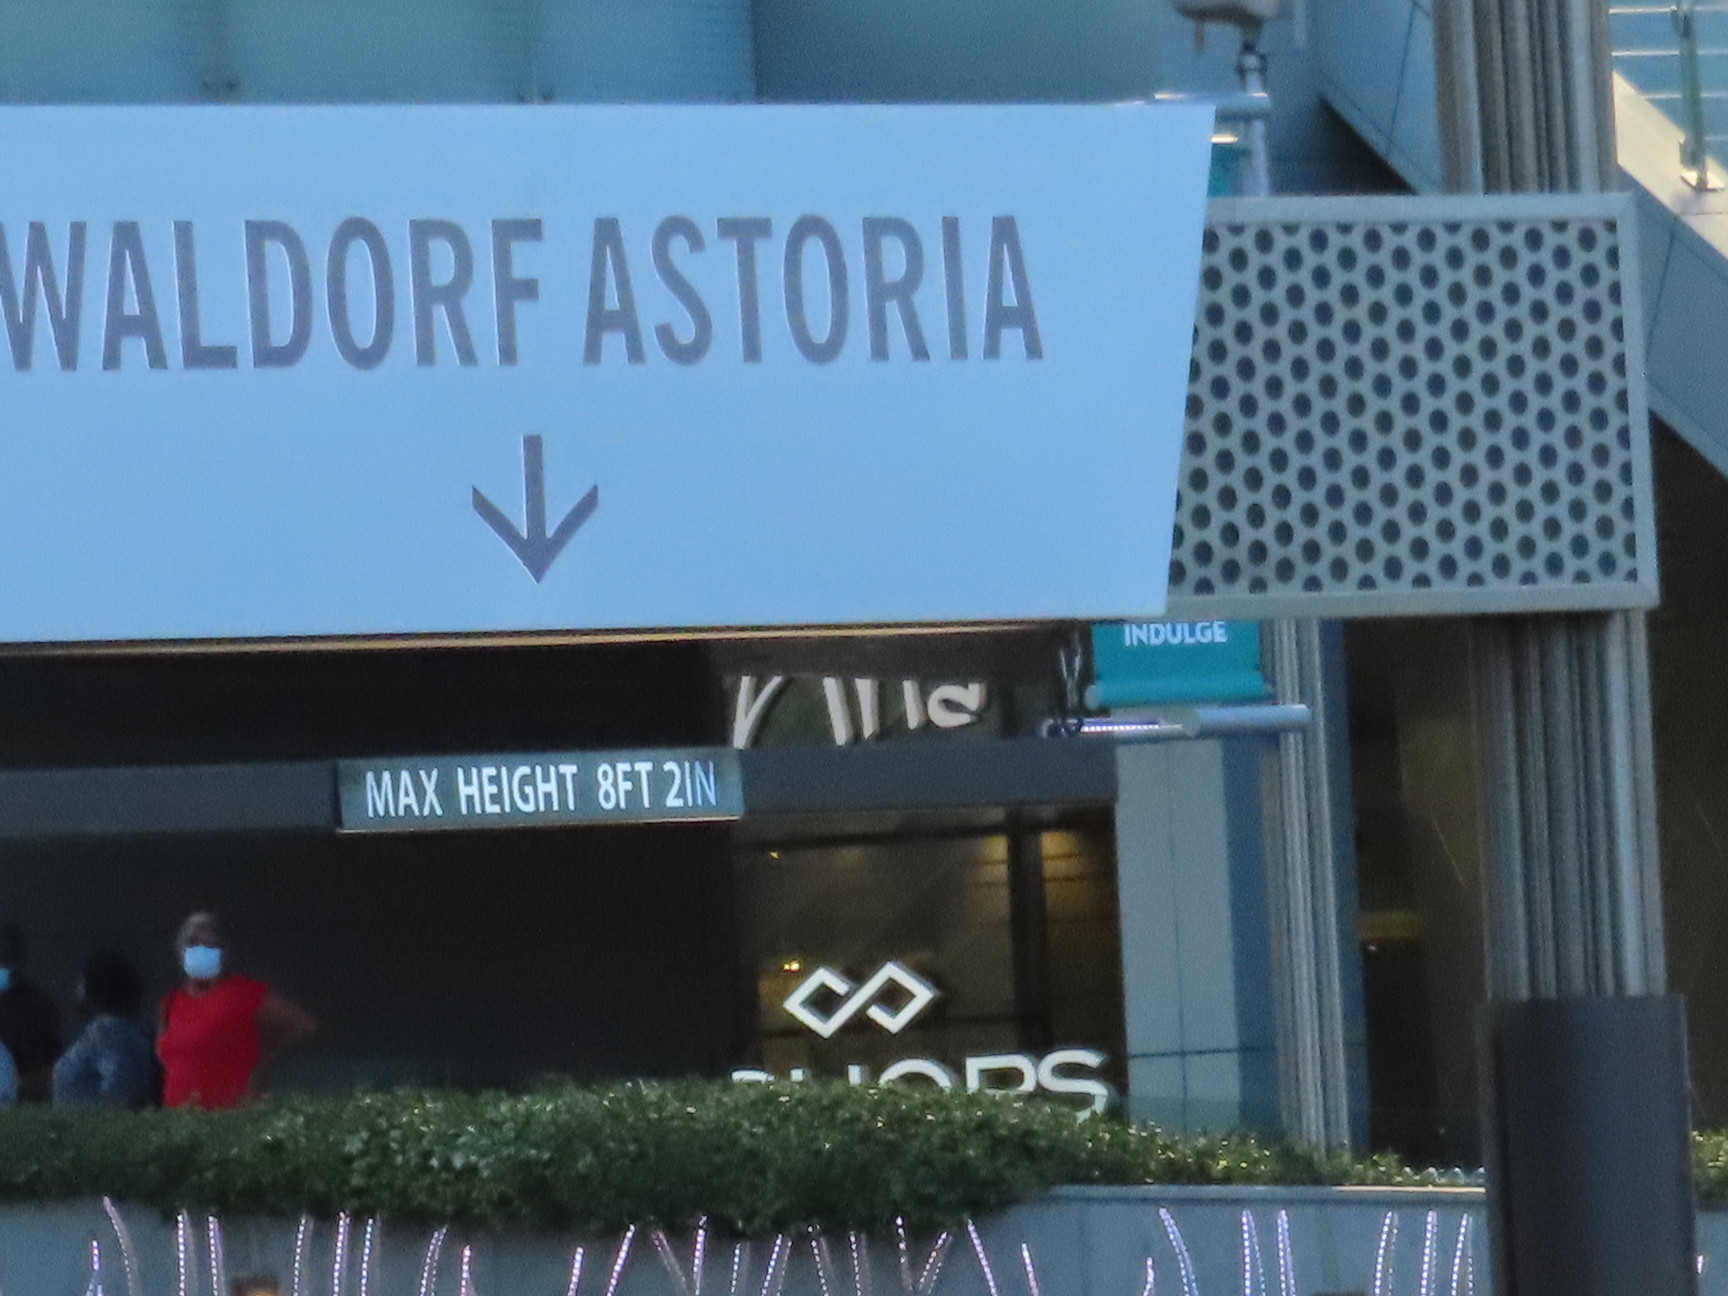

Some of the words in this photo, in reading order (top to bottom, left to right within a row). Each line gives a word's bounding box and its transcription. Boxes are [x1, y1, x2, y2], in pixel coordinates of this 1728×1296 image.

[582, 214, 1043, 366] ASTORIA
[1123, 620, 1228, 647] INDULGE
[366, 766, 444, 818] MAX
[457, 763, 578, 815] HEIGHT
[597, 761, 653, 810] 8FT
[663, 760, 718, 808] 2IN
